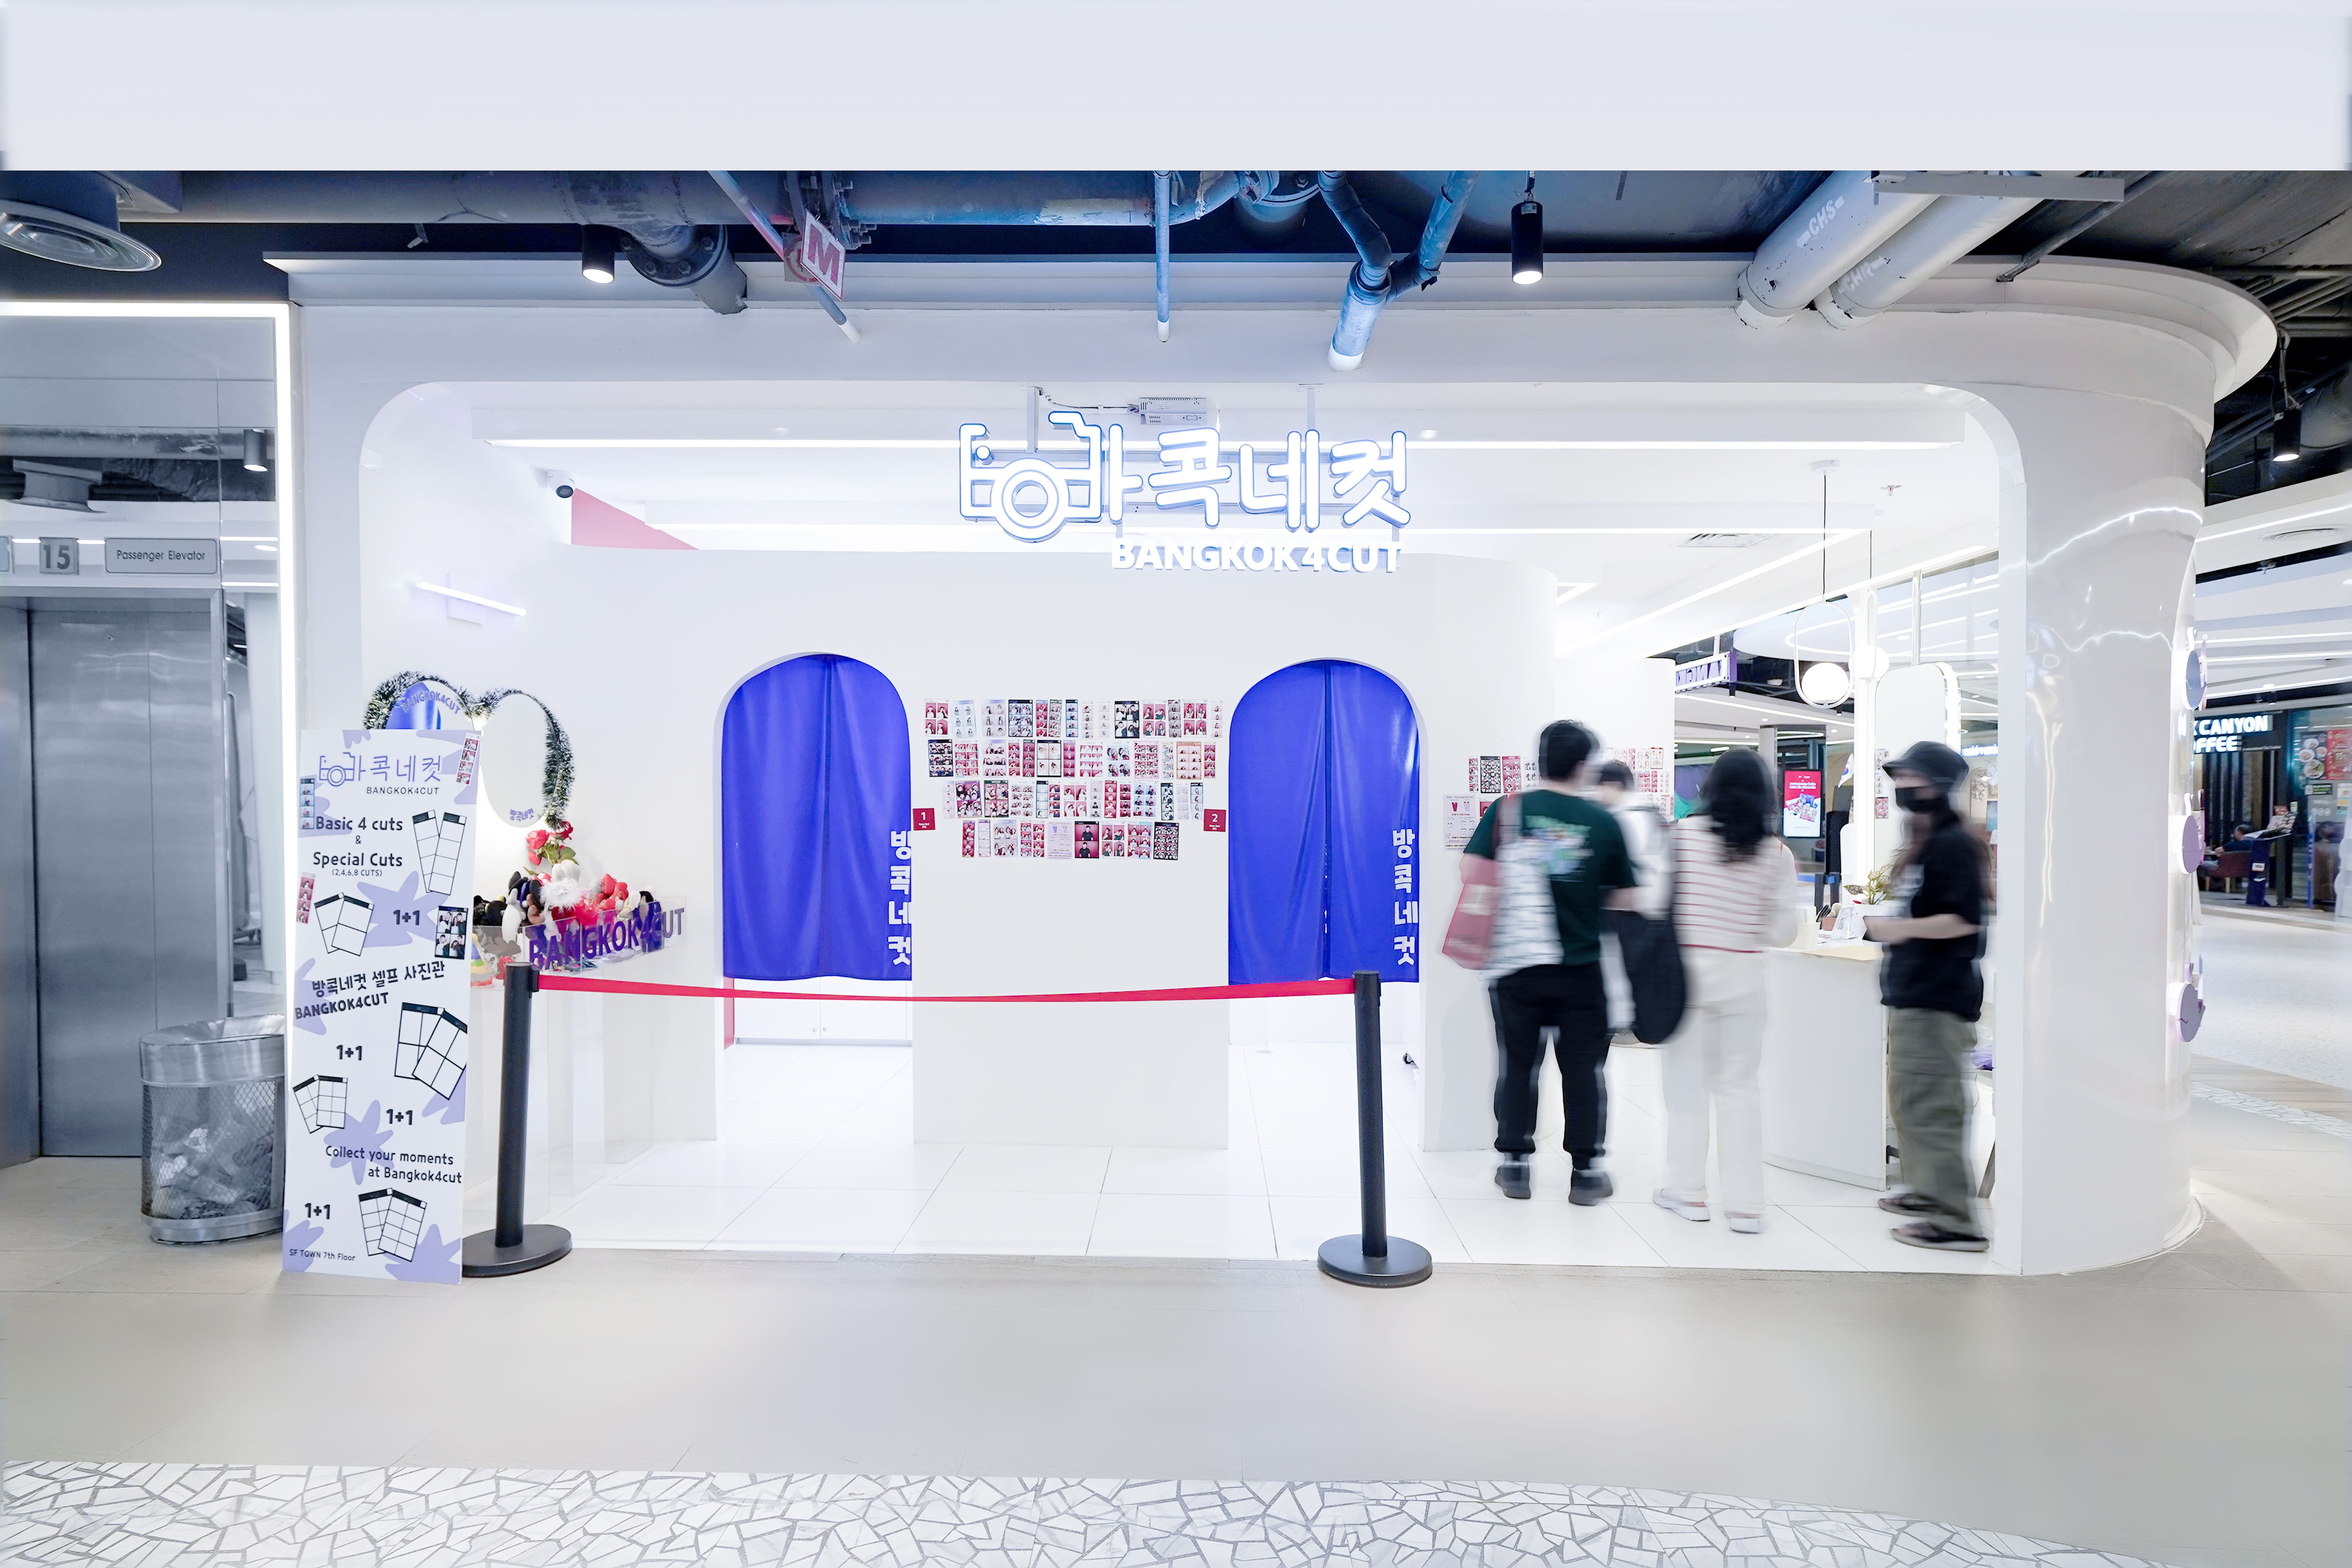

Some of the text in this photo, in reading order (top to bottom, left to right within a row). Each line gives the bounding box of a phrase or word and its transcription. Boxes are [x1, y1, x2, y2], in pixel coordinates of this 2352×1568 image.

[1808, 199, 1836, 236] CHS
[808, 223, 840, 285] M
[43, 544, 70, 570] 15
[117, 550, 205, 562] Passenger Elevator
[1111, 539, 1405, 573] BANGKOK4CUT
[2198, 714, 2269, 736] CANYON
[2194, 735, 2238, 753] FFEE
[366, 786, 439, 795] BANGKOK4CUT
[316, 816, 403, 831] Basic 4 cuts
[920, 811, 926, 821] 1
[1212, 813, 1218, 822] 2
[355, 835, 361, 844] &
[313, 852, 402, 868] Special Cuts
[888, 831, 911, 965] 방콕네컷
[1392, 829, 1418, 965] 방콕네컷
[392, 909, 420, 926] 1+1
[530, 907, 684, 971] BANGKOK4CUT
[312, 960, 445, 997] 방콕네컷 셀프 사진관
[295, 992, 388, 1020] BANGKOK4CUT
[336, 1045, 363, 1061] 1+1
[386, 1109, 413, 1125] 1+1
[325, 1145, 454, 1165] Collect your moments
[368, 1167, 462, 1183] at Bangkok4cut
[304, 1203, 331, 1220] 1+1
[300, 1249, 321, 1258] TOWN
[323, 1252, 335, 1260] 7th
[337, 1252, 356, 1261] Floor
